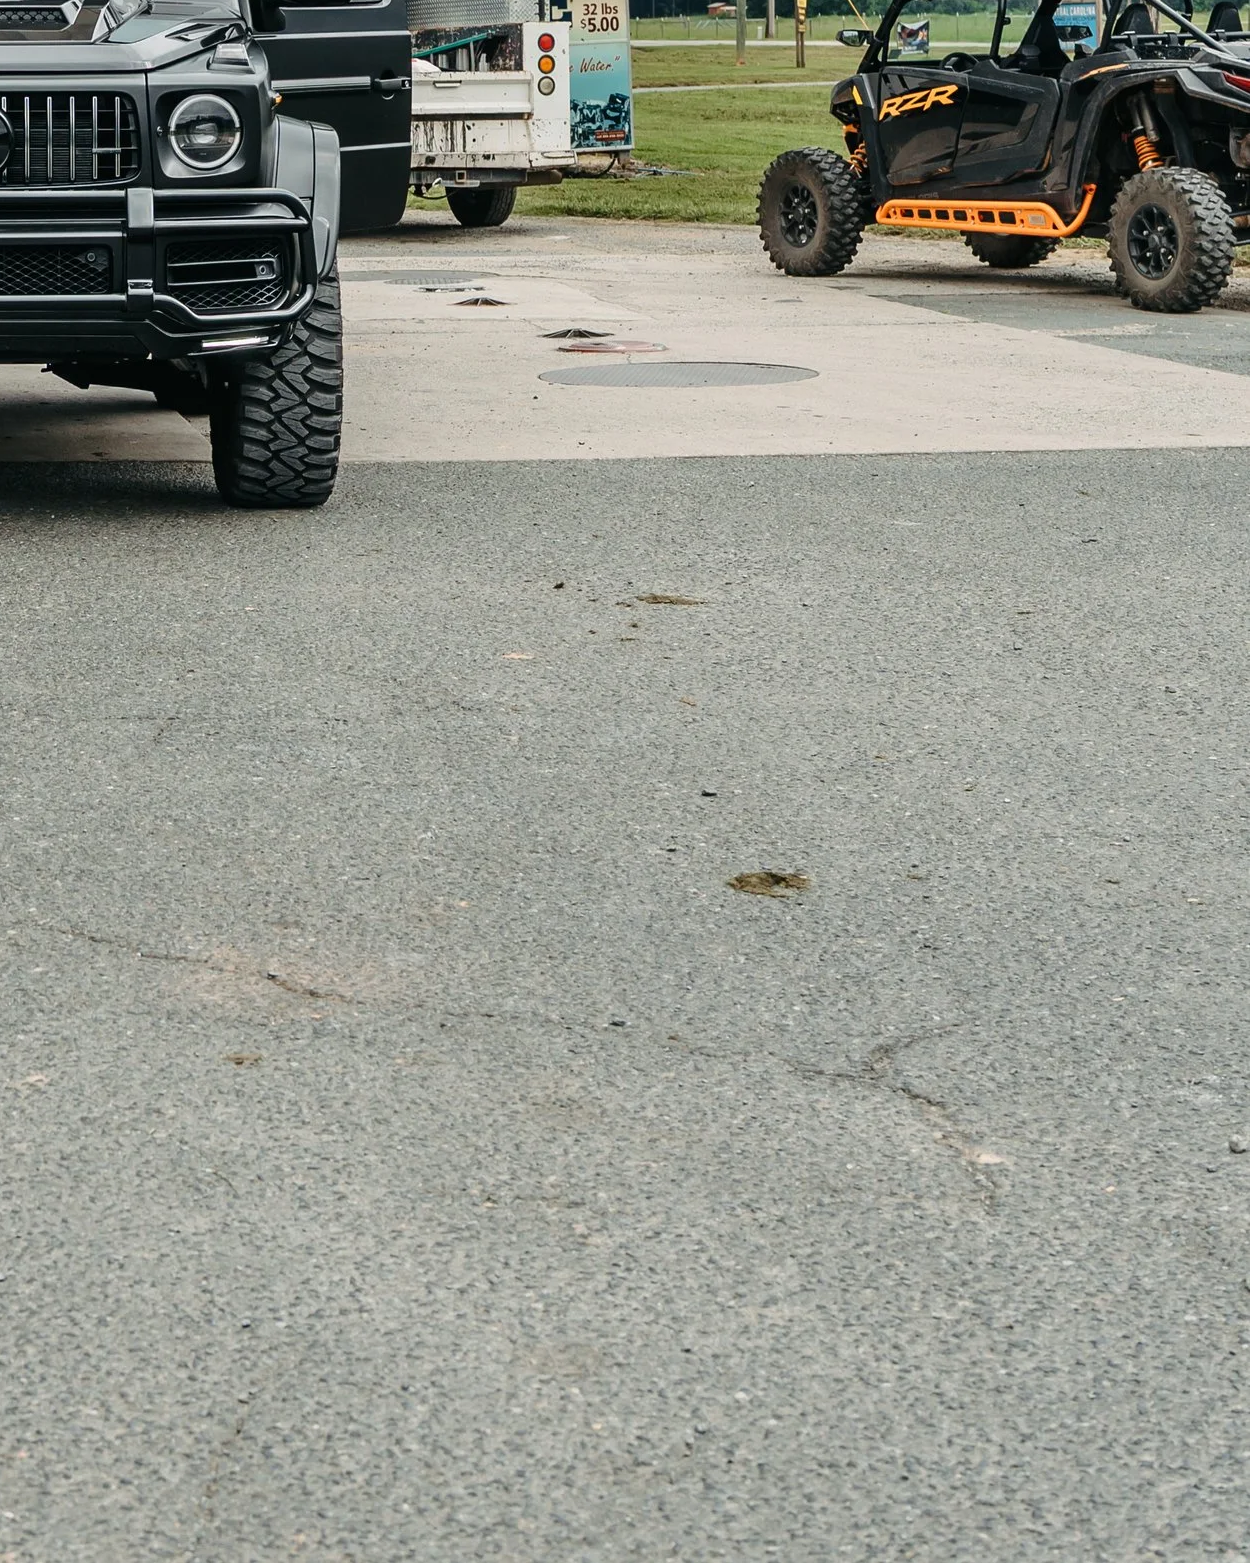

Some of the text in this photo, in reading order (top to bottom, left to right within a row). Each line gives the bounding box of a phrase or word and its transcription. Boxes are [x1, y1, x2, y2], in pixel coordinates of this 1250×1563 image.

[583, 3, 618, 16] 32 lbs
[580, 16, 619, 32] $5.00
[878, 84, 959, 121] RZR
